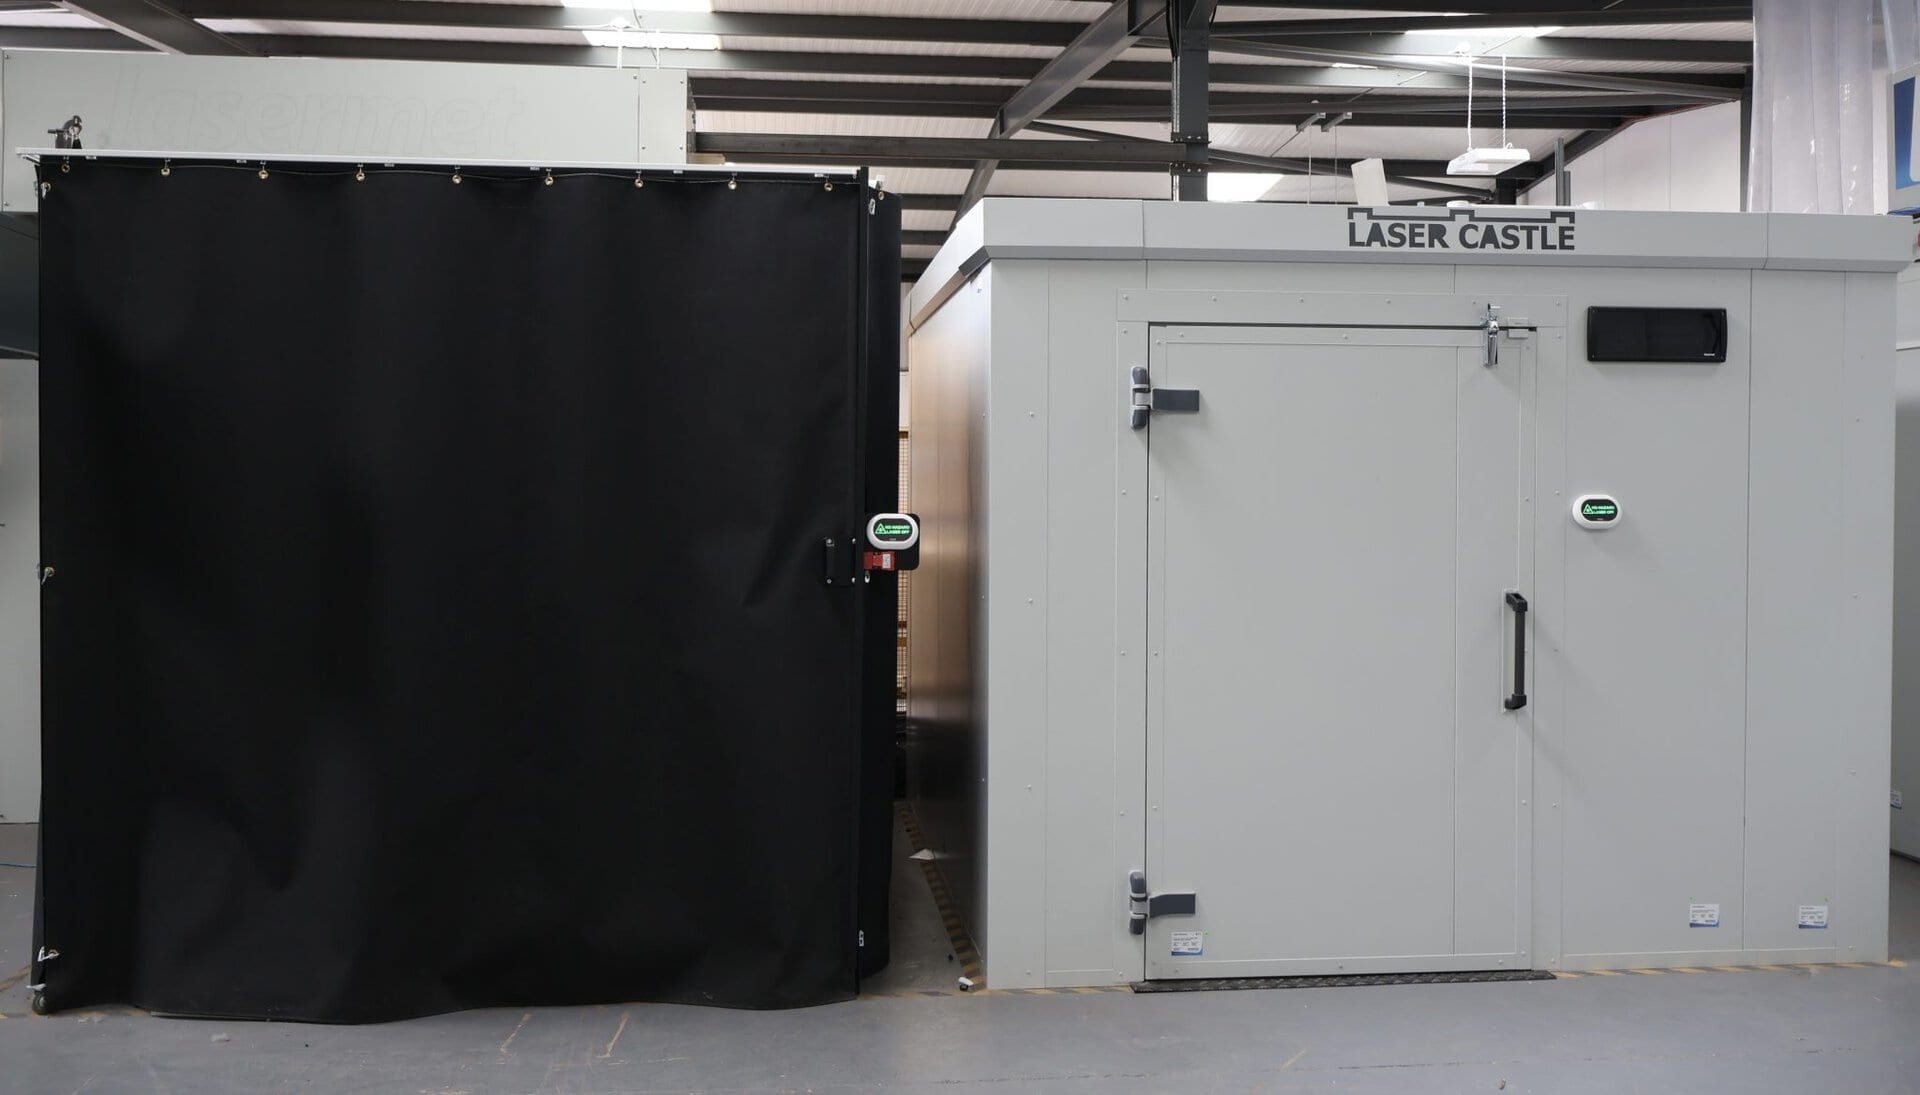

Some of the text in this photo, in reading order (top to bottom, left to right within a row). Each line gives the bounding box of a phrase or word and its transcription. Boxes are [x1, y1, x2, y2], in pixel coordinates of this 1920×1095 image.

[101, 63, 527, 155] lasermet
[1348, 222, 1575, 250] LASER CASTLE
